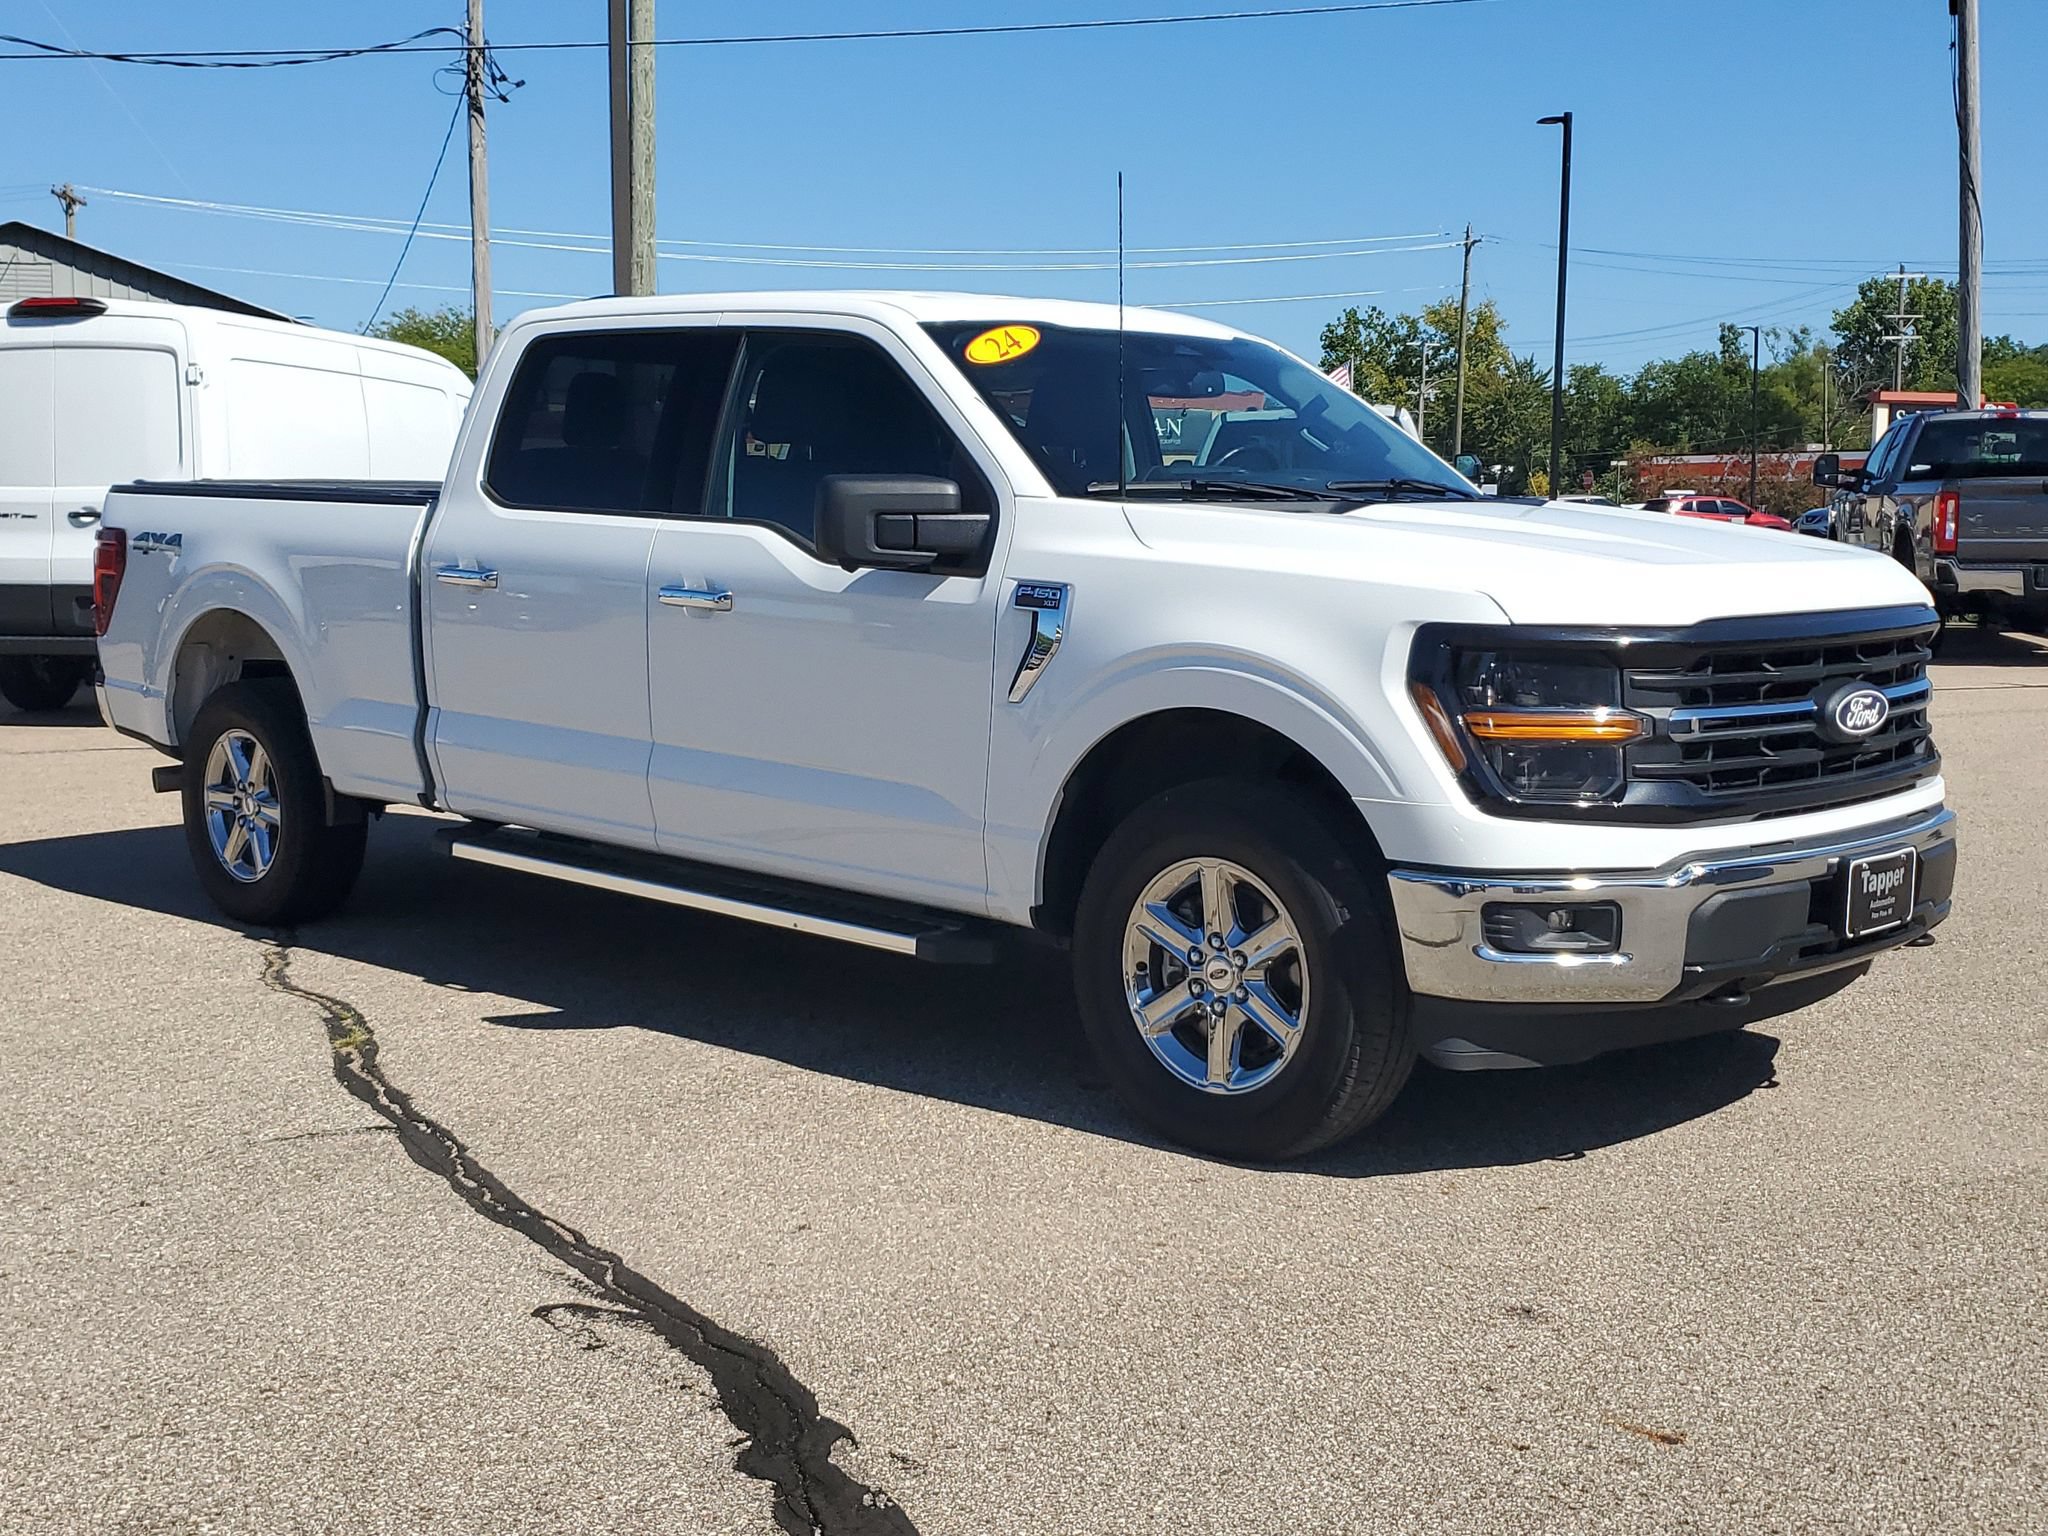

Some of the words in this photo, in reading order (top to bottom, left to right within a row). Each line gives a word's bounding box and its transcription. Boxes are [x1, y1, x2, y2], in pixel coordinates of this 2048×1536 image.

[984, 329, 1023, 359] 24
[1017, 586, 1061, 600] F-150
[1845, 695, 1882, 728] Ford
[1861, 867, 1905, 896] Tapper
